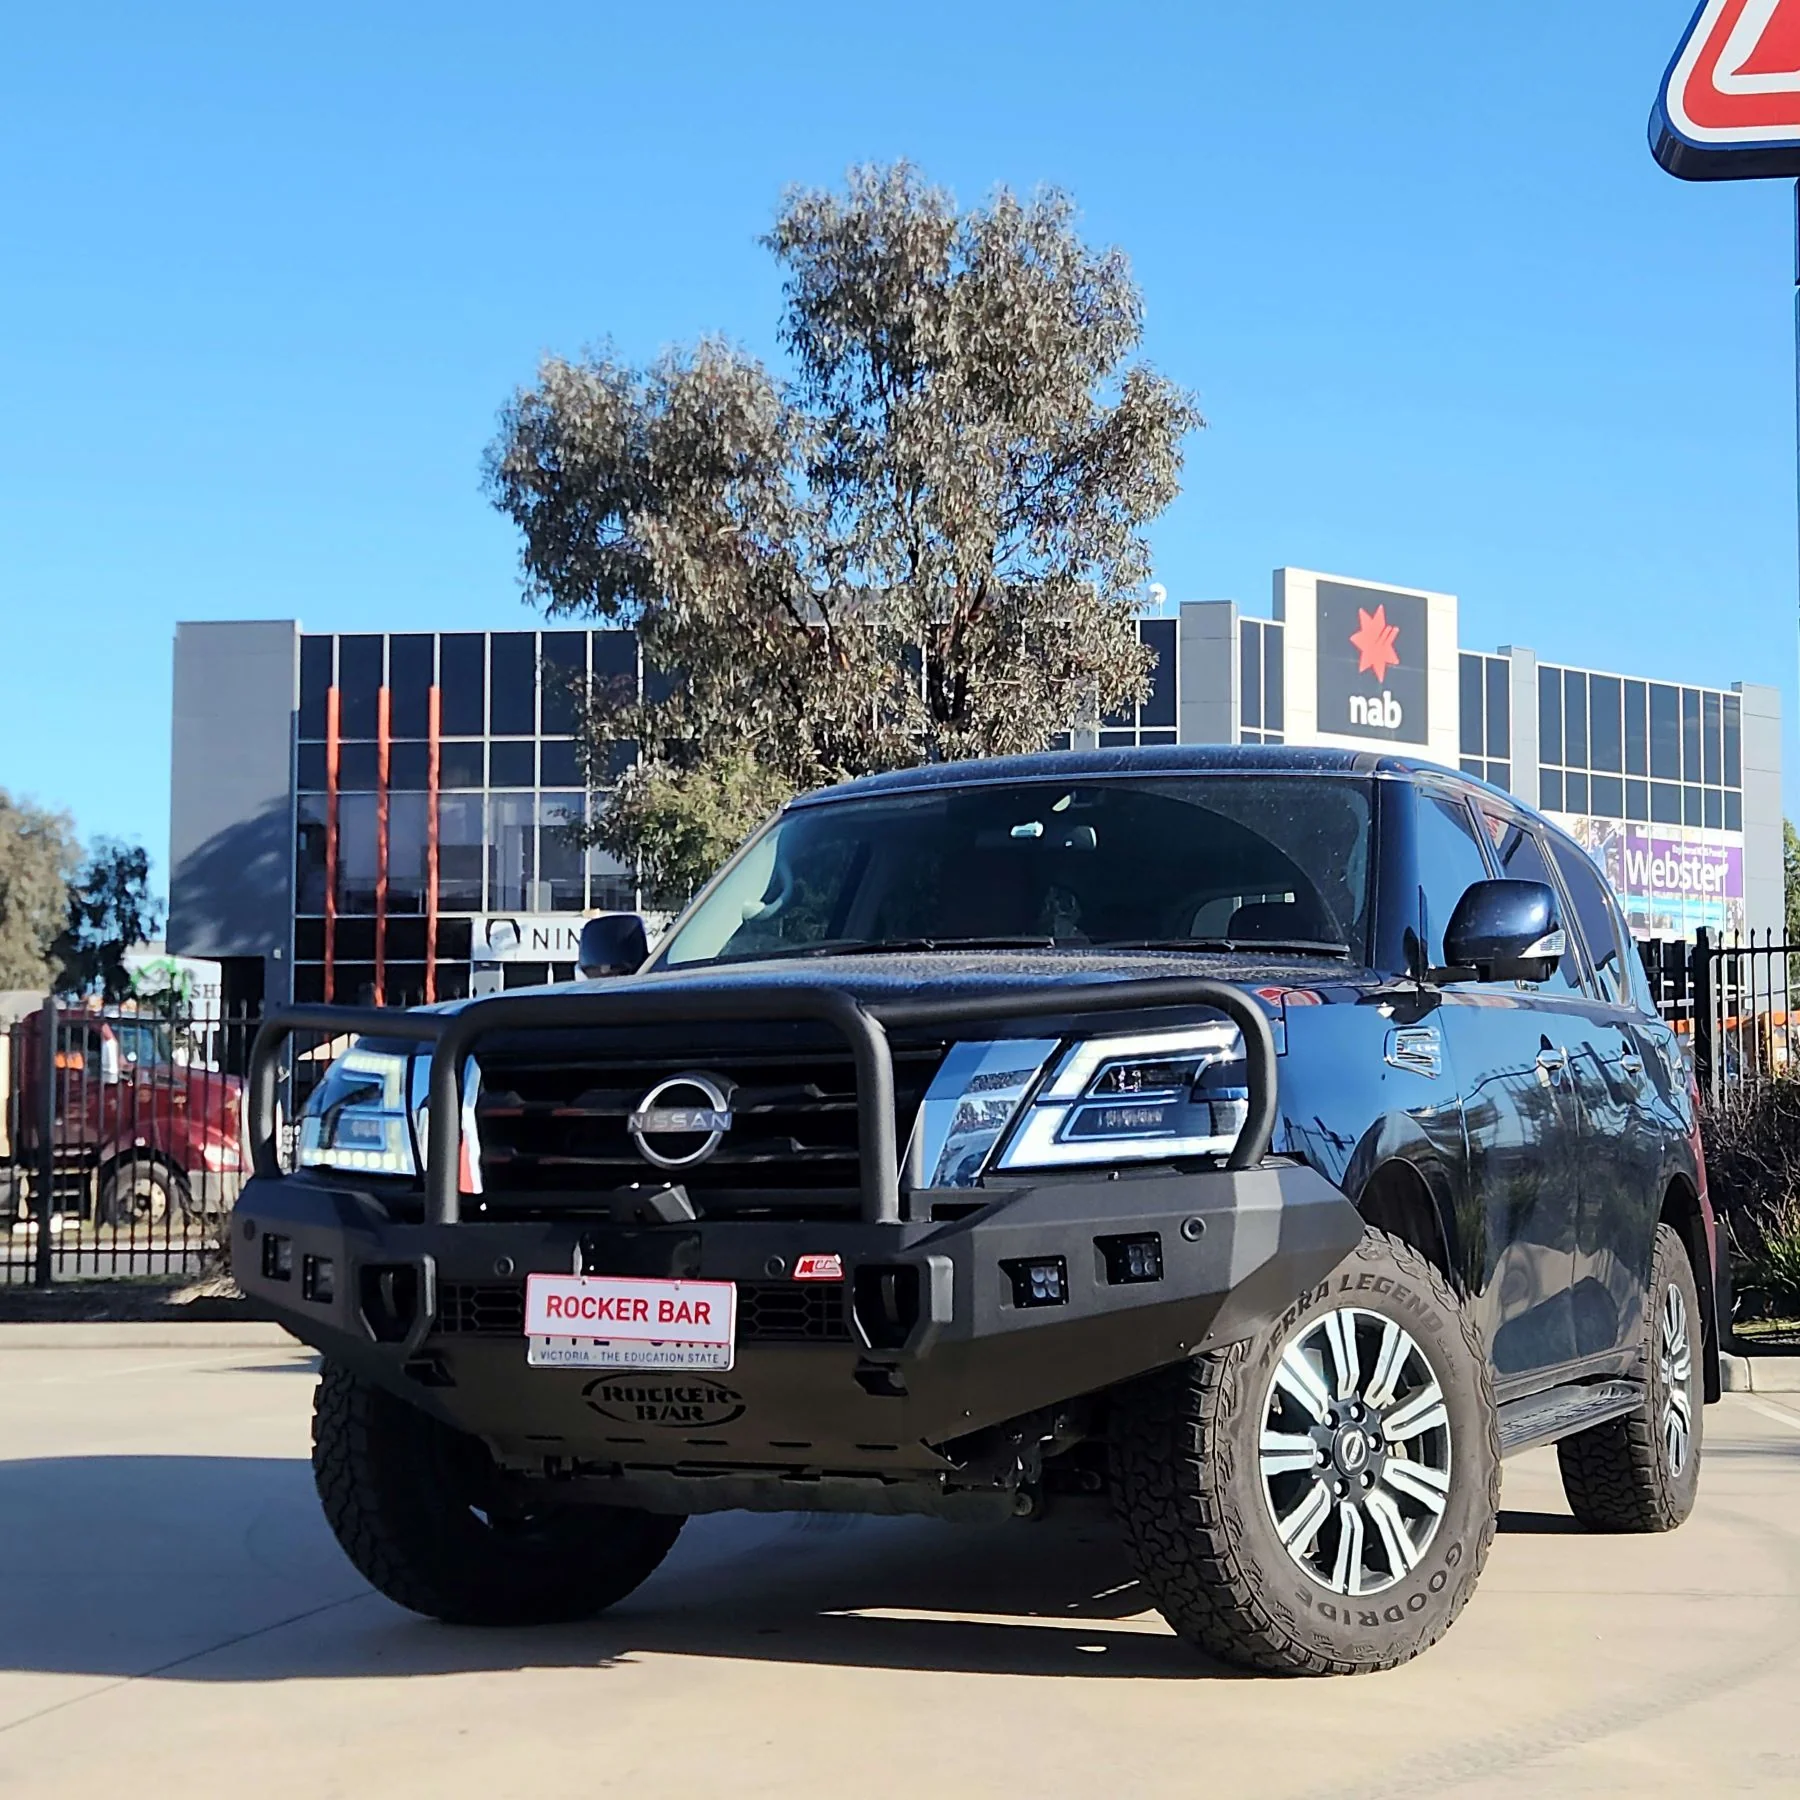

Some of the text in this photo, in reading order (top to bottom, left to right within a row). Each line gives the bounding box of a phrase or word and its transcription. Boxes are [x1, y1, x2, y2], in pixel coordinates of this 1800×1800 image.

[1349, 690, 1402, 729] nab
[1626, 848, 1729, 892] Webster
[628, 1112, 729, 1130] NISSAN
[546, 1295, 711, 1325] ROCKER BAR
[1258, 1273, 1444, 1369] TERRA LEGEND
[540, 1351, 590, 1361] VICTORIA
[601, 1352, 620, 1362] THE
[624, 1352, 684, 1363] EDUCATION
[687, 1353, 719, 1364] STATE
[602, 1386, 729, 1404] ROCKER
[636, 1405, 705, 1421] BAR
[1294, 1541, 1463, 1627] GOODRIDE
